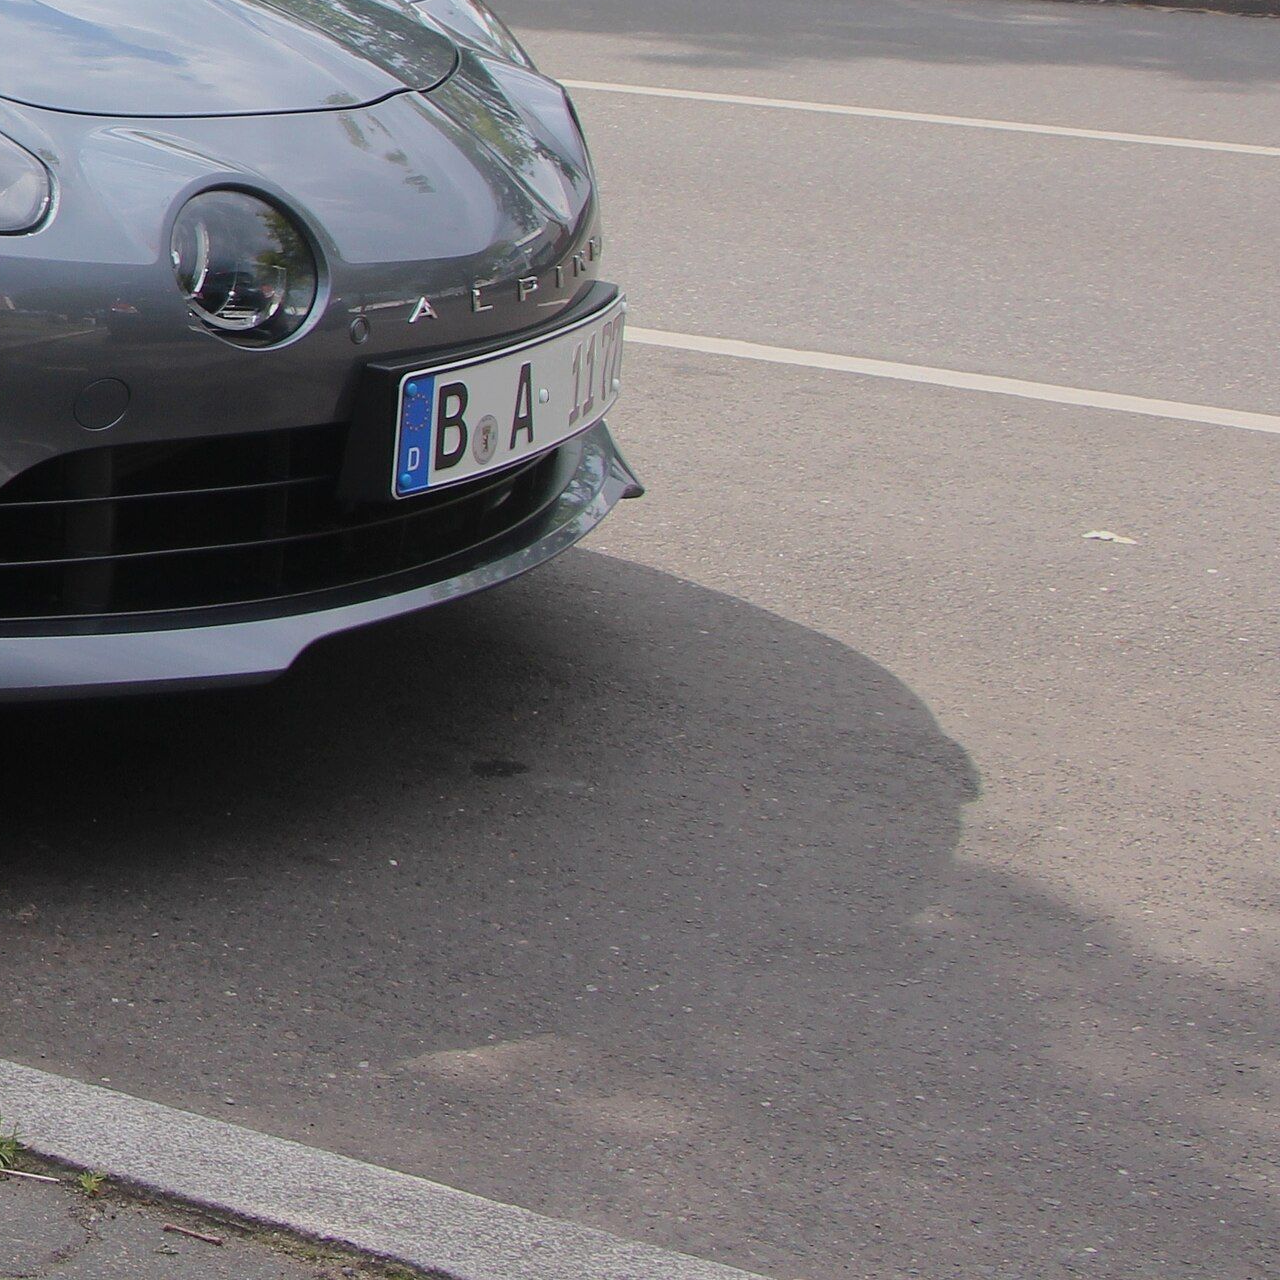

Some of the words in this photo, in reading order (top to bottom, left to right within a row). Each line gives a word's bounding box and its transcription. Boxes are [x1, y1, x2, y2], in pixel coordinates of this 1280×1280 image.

[435, 381, 469, 470] B
[509, 361, 534, 450] A
[407, 447, 420, 472] D
